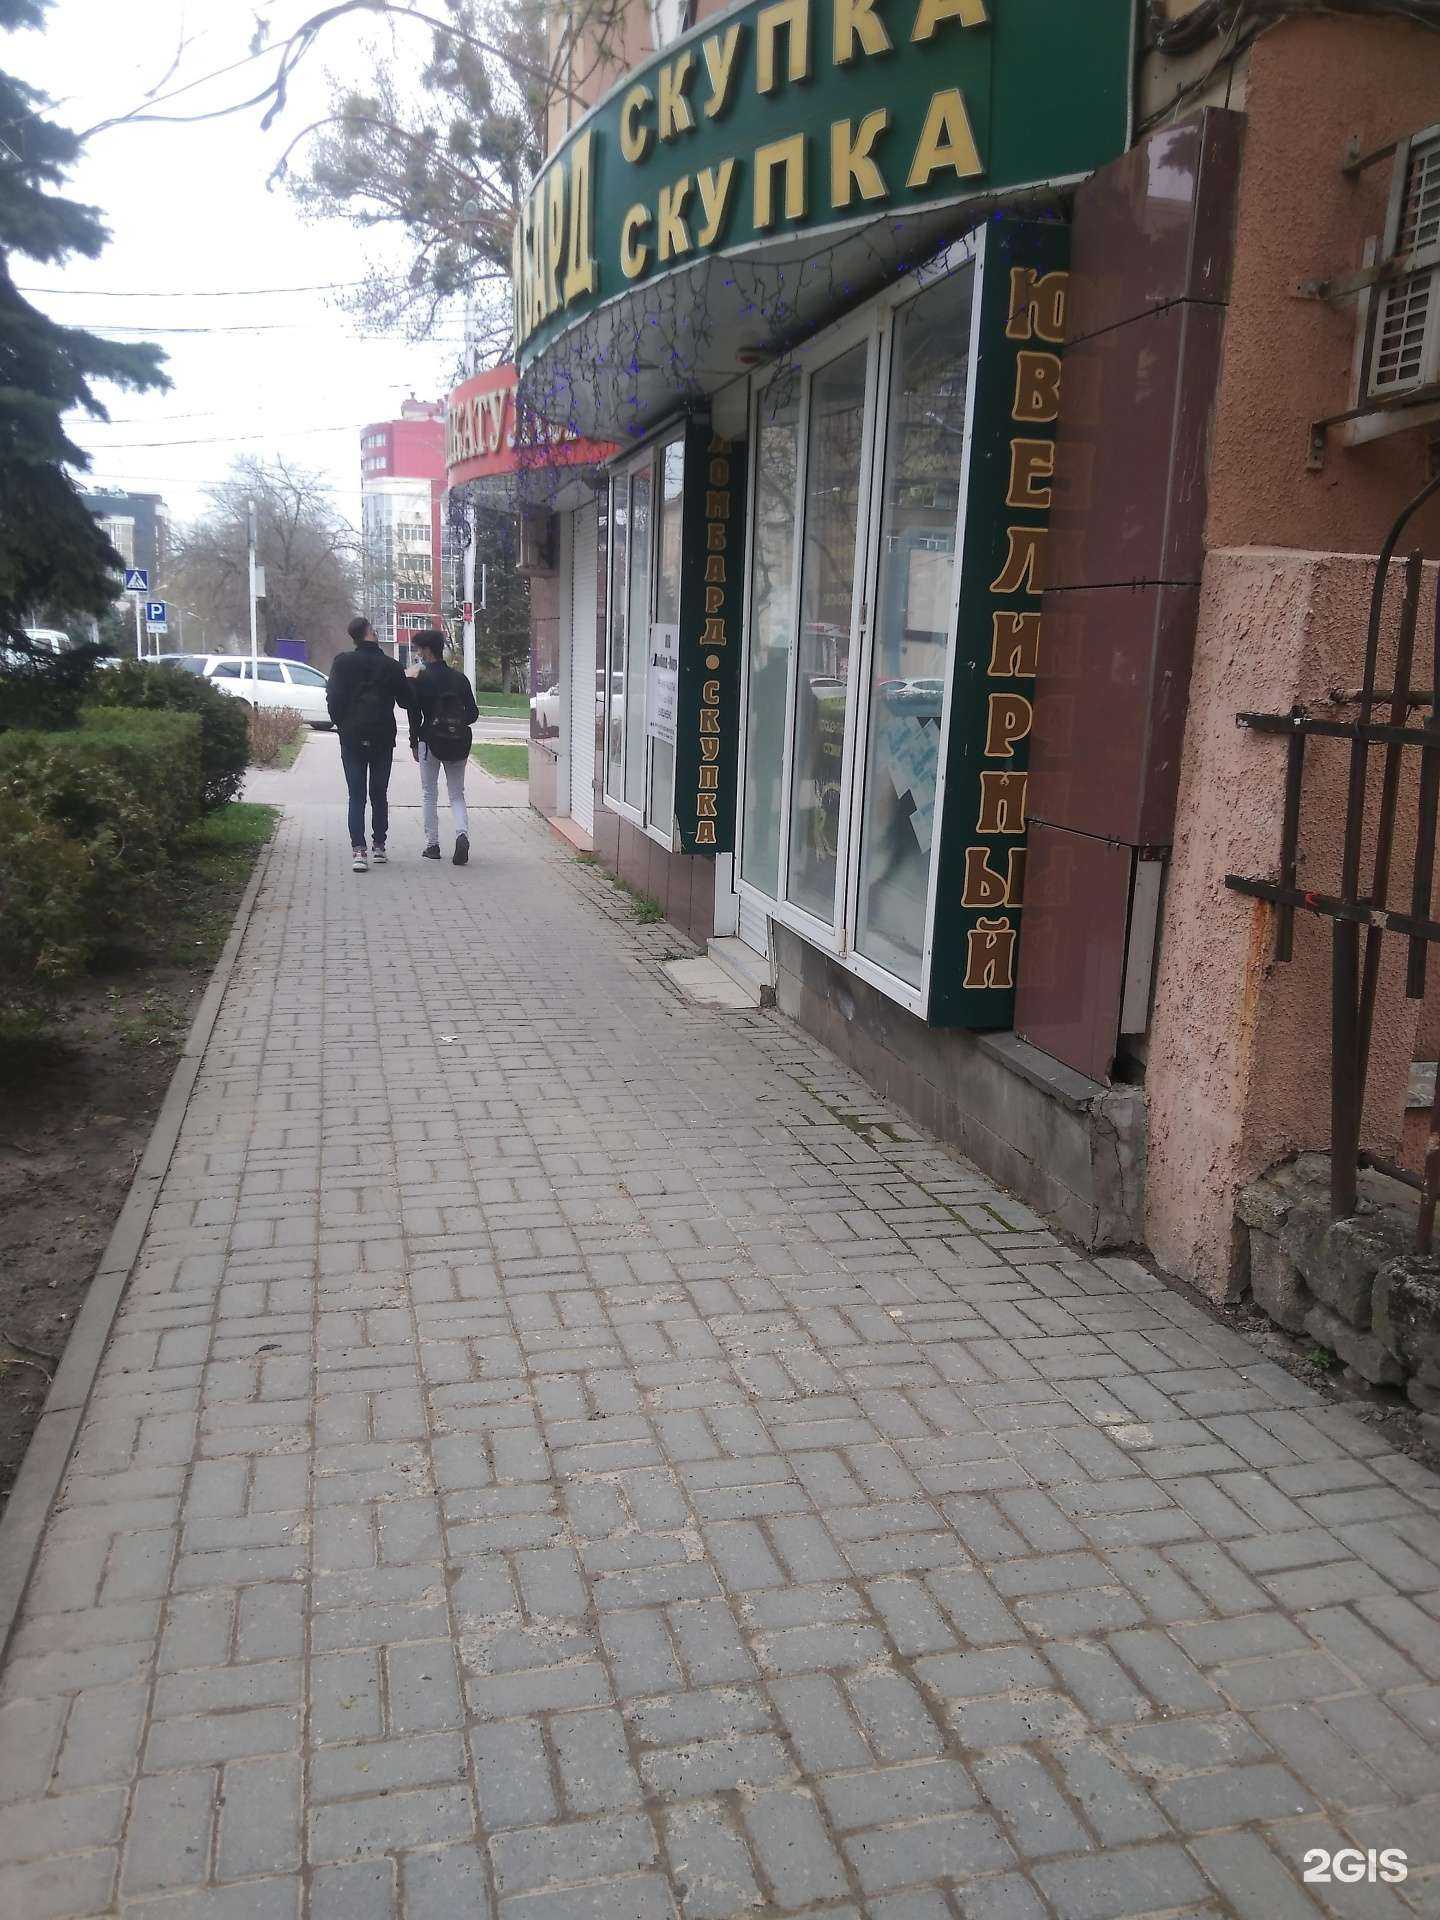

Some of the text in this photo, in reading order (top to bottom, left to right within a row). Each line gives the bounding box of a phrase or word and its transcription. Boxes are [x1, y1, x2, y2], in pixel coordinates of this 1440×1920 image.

[620, 88, 983, 279] СКУПКА
[151, 604, 162, 620] P
[695, 434, 731, 844] ЛОМБАРД СКУПКА
[961, 267, 1069, 989] ЮВЕЛИРНЫЙ
